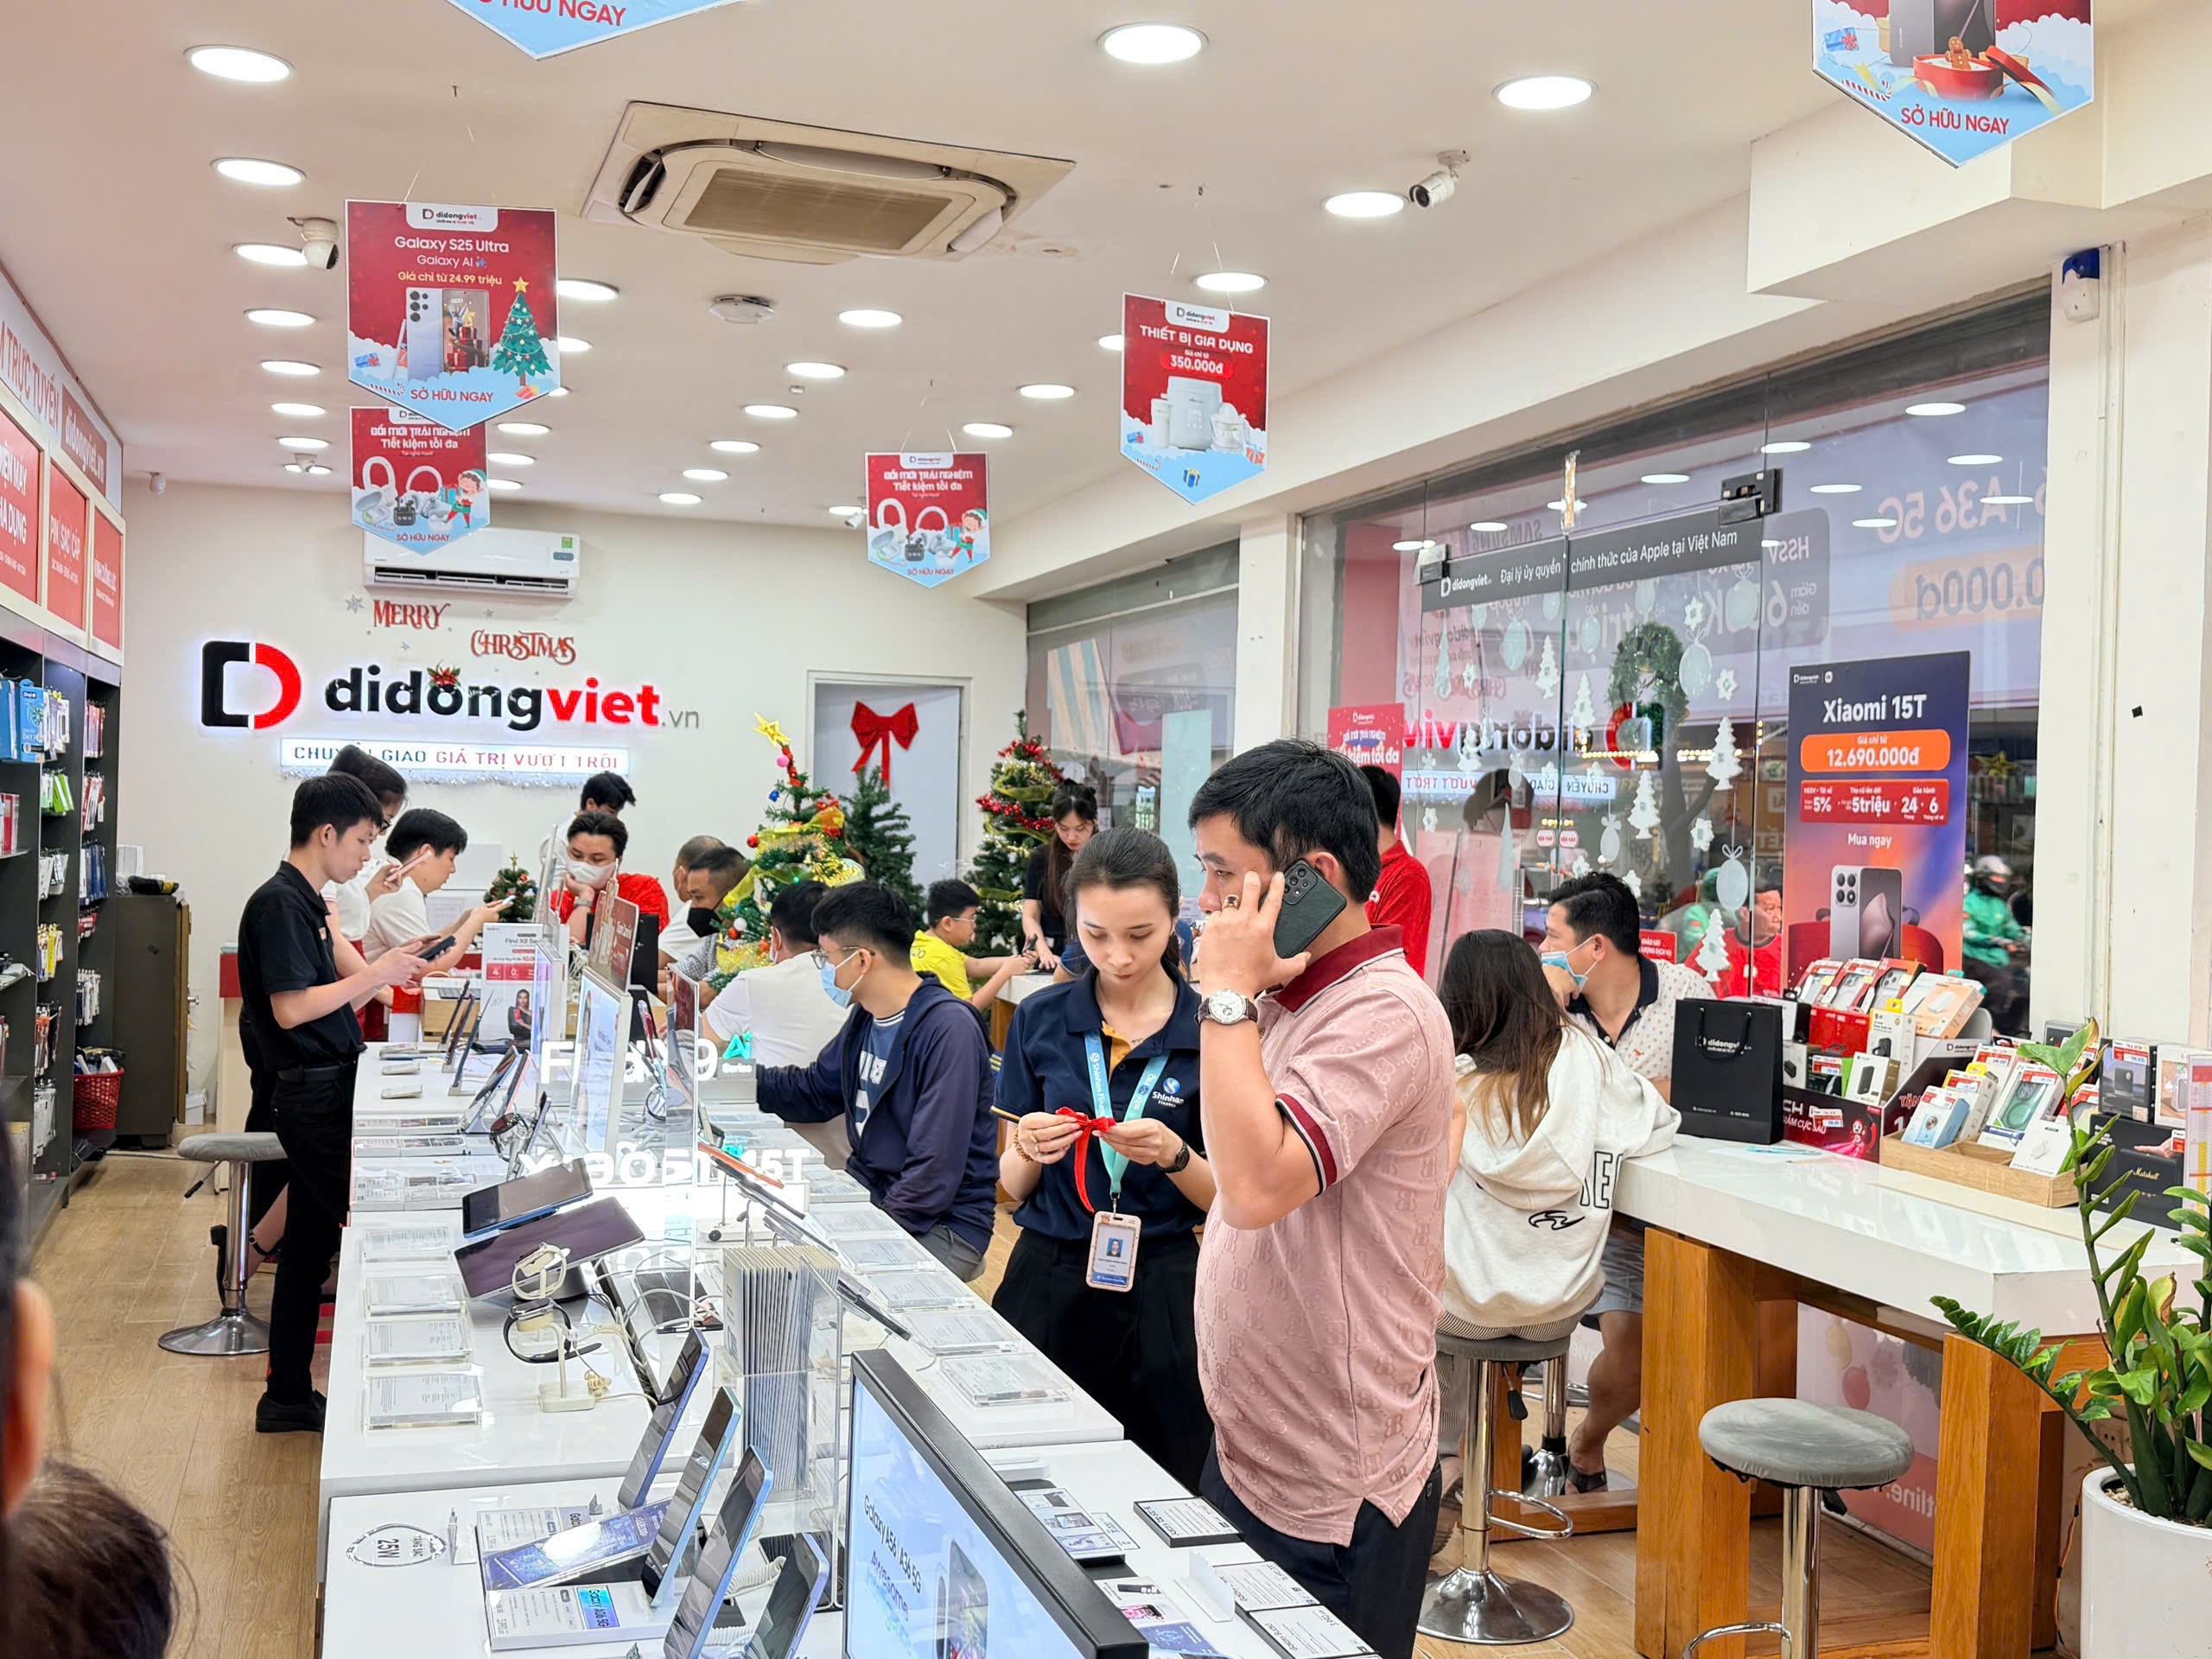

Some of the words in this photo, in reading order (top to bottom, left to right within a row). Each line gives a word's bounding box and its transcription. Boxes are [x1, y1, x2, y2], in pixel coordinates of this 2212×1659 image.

[558, 0, 626, 28] NGAY
[1901, 103, 1925, 127] SỞ
[1929, 106, 1961, 130] HỮU
[1966, 114, 2011, 136] NGAY
[435, 210, 478, 220] didongviet
[394, 236, 447, 253] Galaxy
[449, 238, 474, 251] S25
[476, 240, 510, 253] Ultra
[416, 254, 460, 269] Galaxy
[462, 257, 474, 267] AI
[397, 270, 416, 281] Giá
[418, 271, 435, 282] chỉ
[449, 274, 475, 283] 24.99
[478, 275, 502, 287] triệu
[1140, 324, 1177, 342] THIẾT
[1179, 332, 1192, 346] BỊ
[1194, 334, 1217, 348] GIA
[1218, 339, 1254, 354] DỤNG
[1170, 353, 1224, 375] 350.000đ
[410, 387, 429, 401] SỞ
[432, 388, 456, 402] HỮU
[460, 391, 494, 404] NGAY
[1570, 556, 1596, 575] chính
[1598, 551, 1619, 570] thức
[1620, 549, 1638, 564] của
[1640, 543, 1669, 564] Apple
[1671, 539, 1685, 559] tại
[1687, 533, 1709, 555] Việt
[1711, 531, 1738, 550] Nam
[935, 568, 955, 577] NGAY
[1500, 568, 1514, 585] Đại
[1515, 563, 1522, 582] lý
[373, 600, 450, 629] MERRY
[471, 629, 577, 666] CHRISTMAS
[1822, 694, 1887, 723] Xiaomi
[1891, 694, 1928, 720] 15T
[382, 748, 427, 763] GIAO
[435, 747, 467, 765] GIÁ
[475, 752, 506, 770] TRỊ
[1386, 746, 1400, 764] đa
[1827, 746, 1921, 768] 12.690.000đ
[1814, 796, 1832, 813] 5%
[1852, 795, 1891, 817] 5triệu
[1901, 796, 1918, 814] 24
[1929, 797, 1938, 814] 6
[1847, 832, 1867, 846] Mua
[1869, 835, 1892, 850] ngay
[1152, 1090, 1185, 1104] Shinhan
[377, 1538, 401, 1559] 25W
[864, 1495, 886, 1545] Galaxy
[885, 1525, 897, 1559] A56
[899, 1547, 912, 1580] A36
[912, 1567, 922, 1594] 5G
[588, 1588, 602, 1608] Galaxy
